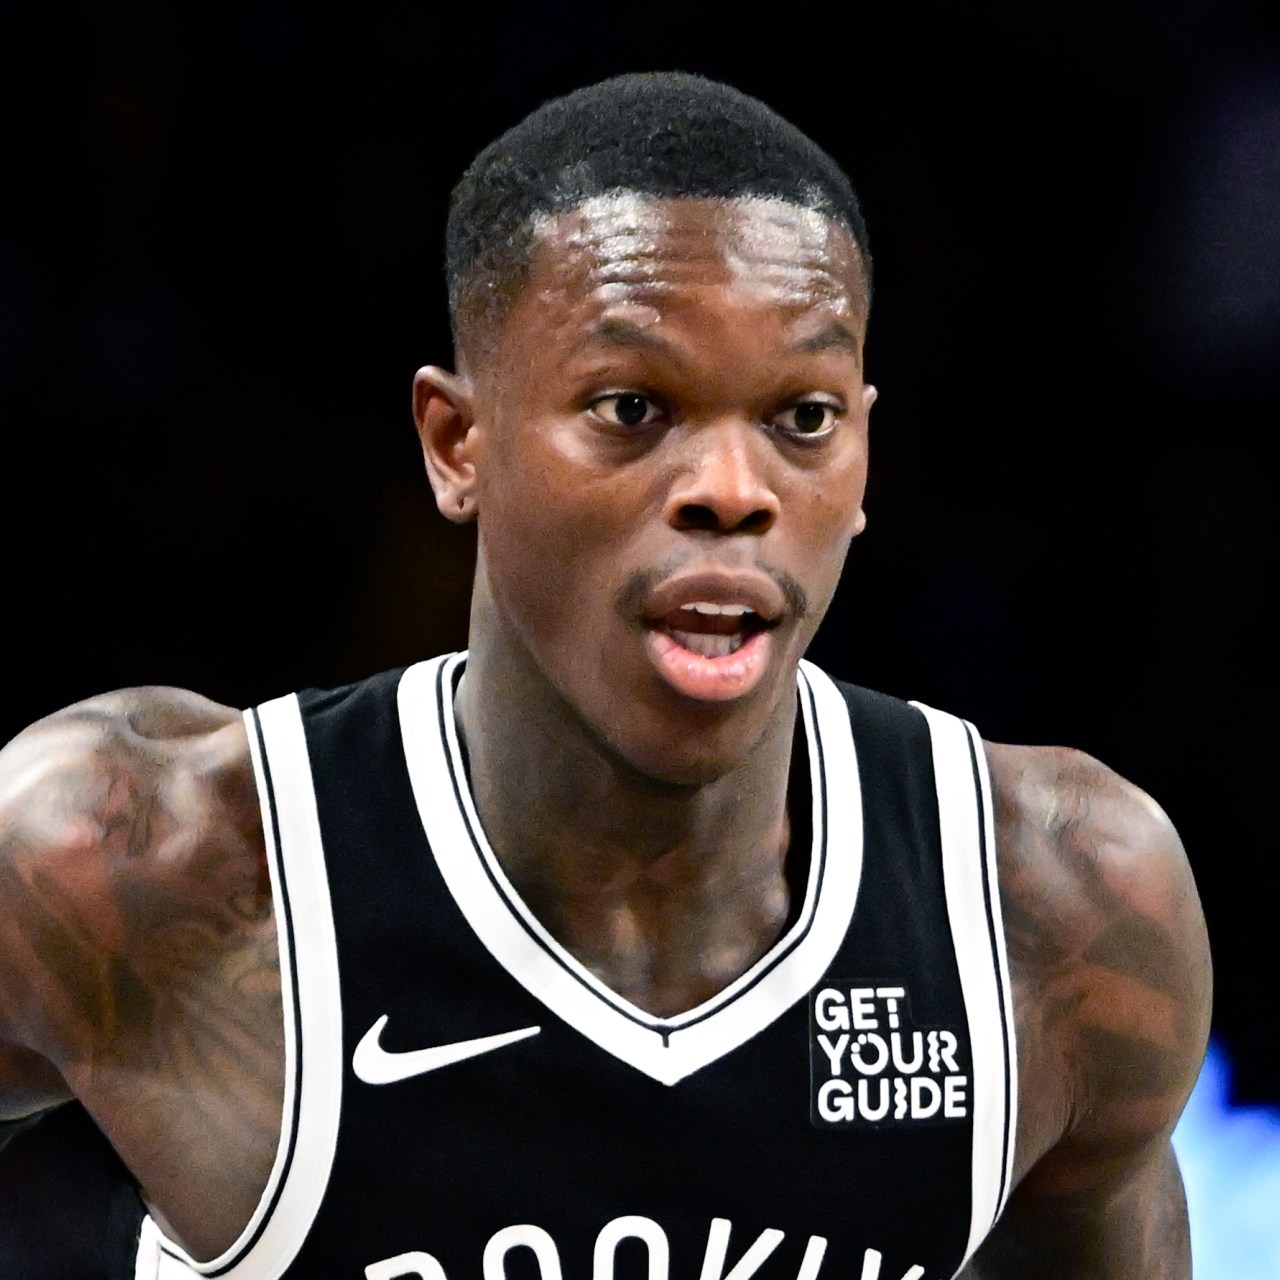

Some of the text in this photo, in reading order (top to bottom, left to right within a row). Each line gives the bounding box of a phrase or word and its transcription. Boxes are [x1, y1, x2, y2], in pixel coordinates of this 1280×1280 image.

[815, 987, 905, 1031] GET
[817, 1031, 960, 1076] YOUR
[818, 1076, 967, 1122] GUIDE
